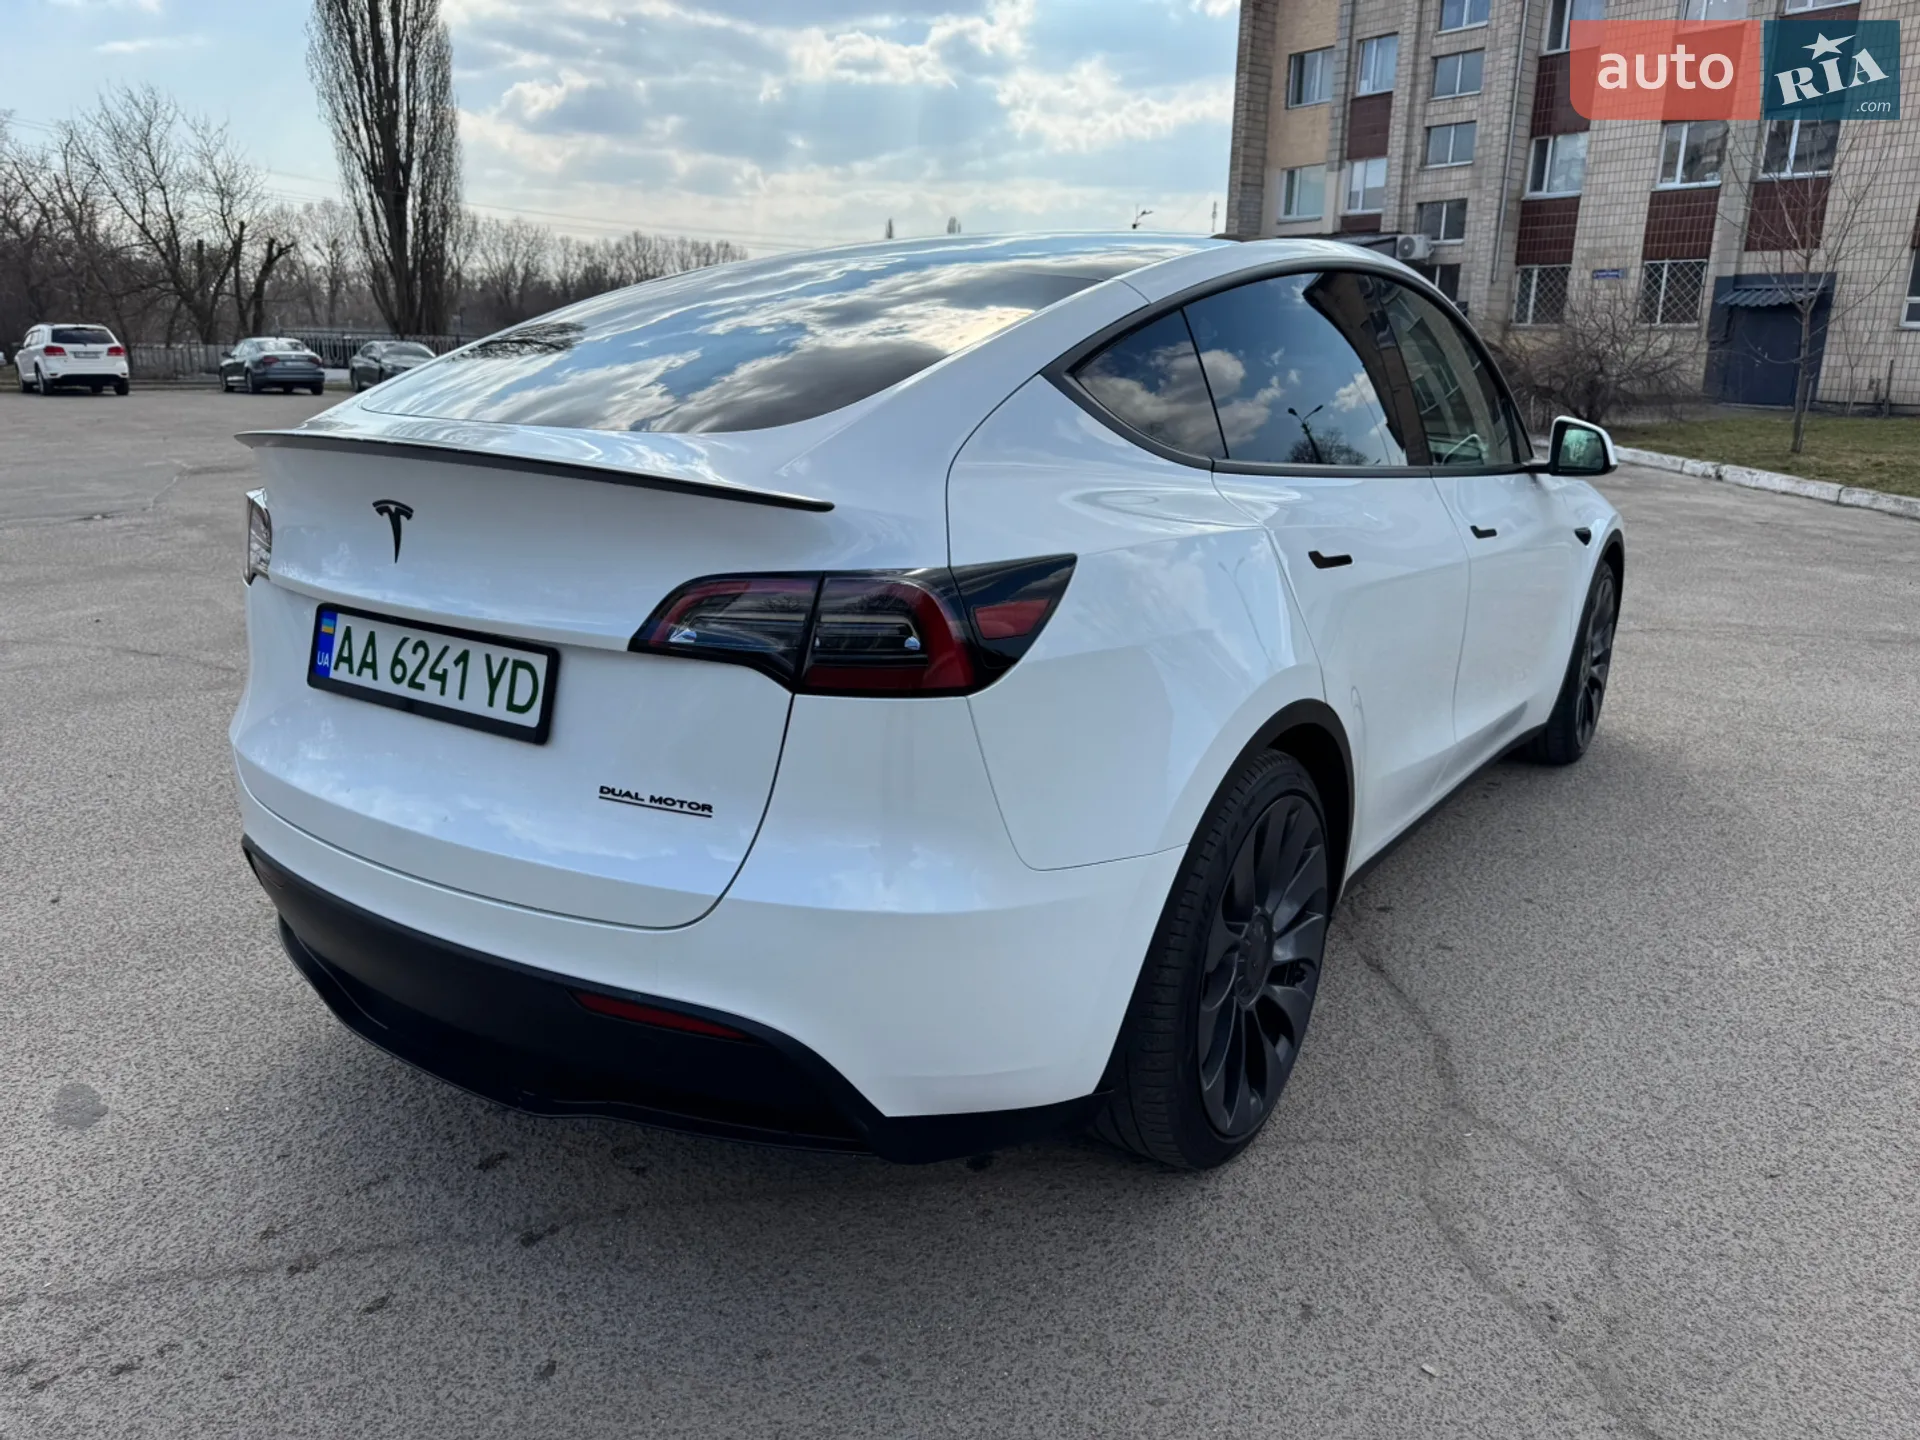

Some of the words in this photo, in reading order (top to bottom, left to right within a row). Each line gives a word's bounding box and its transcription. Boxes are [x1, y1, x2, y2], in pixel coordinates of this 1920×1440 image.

[316, 650, 330, 669] UA
[333, 625, 378, 681] AA
[390, 637, 471, 700] 6241
[485, 653, 540, 715] YD
[598, 785, 645, 802] DUAL
[649, 795, 713, 813] MOTOR
